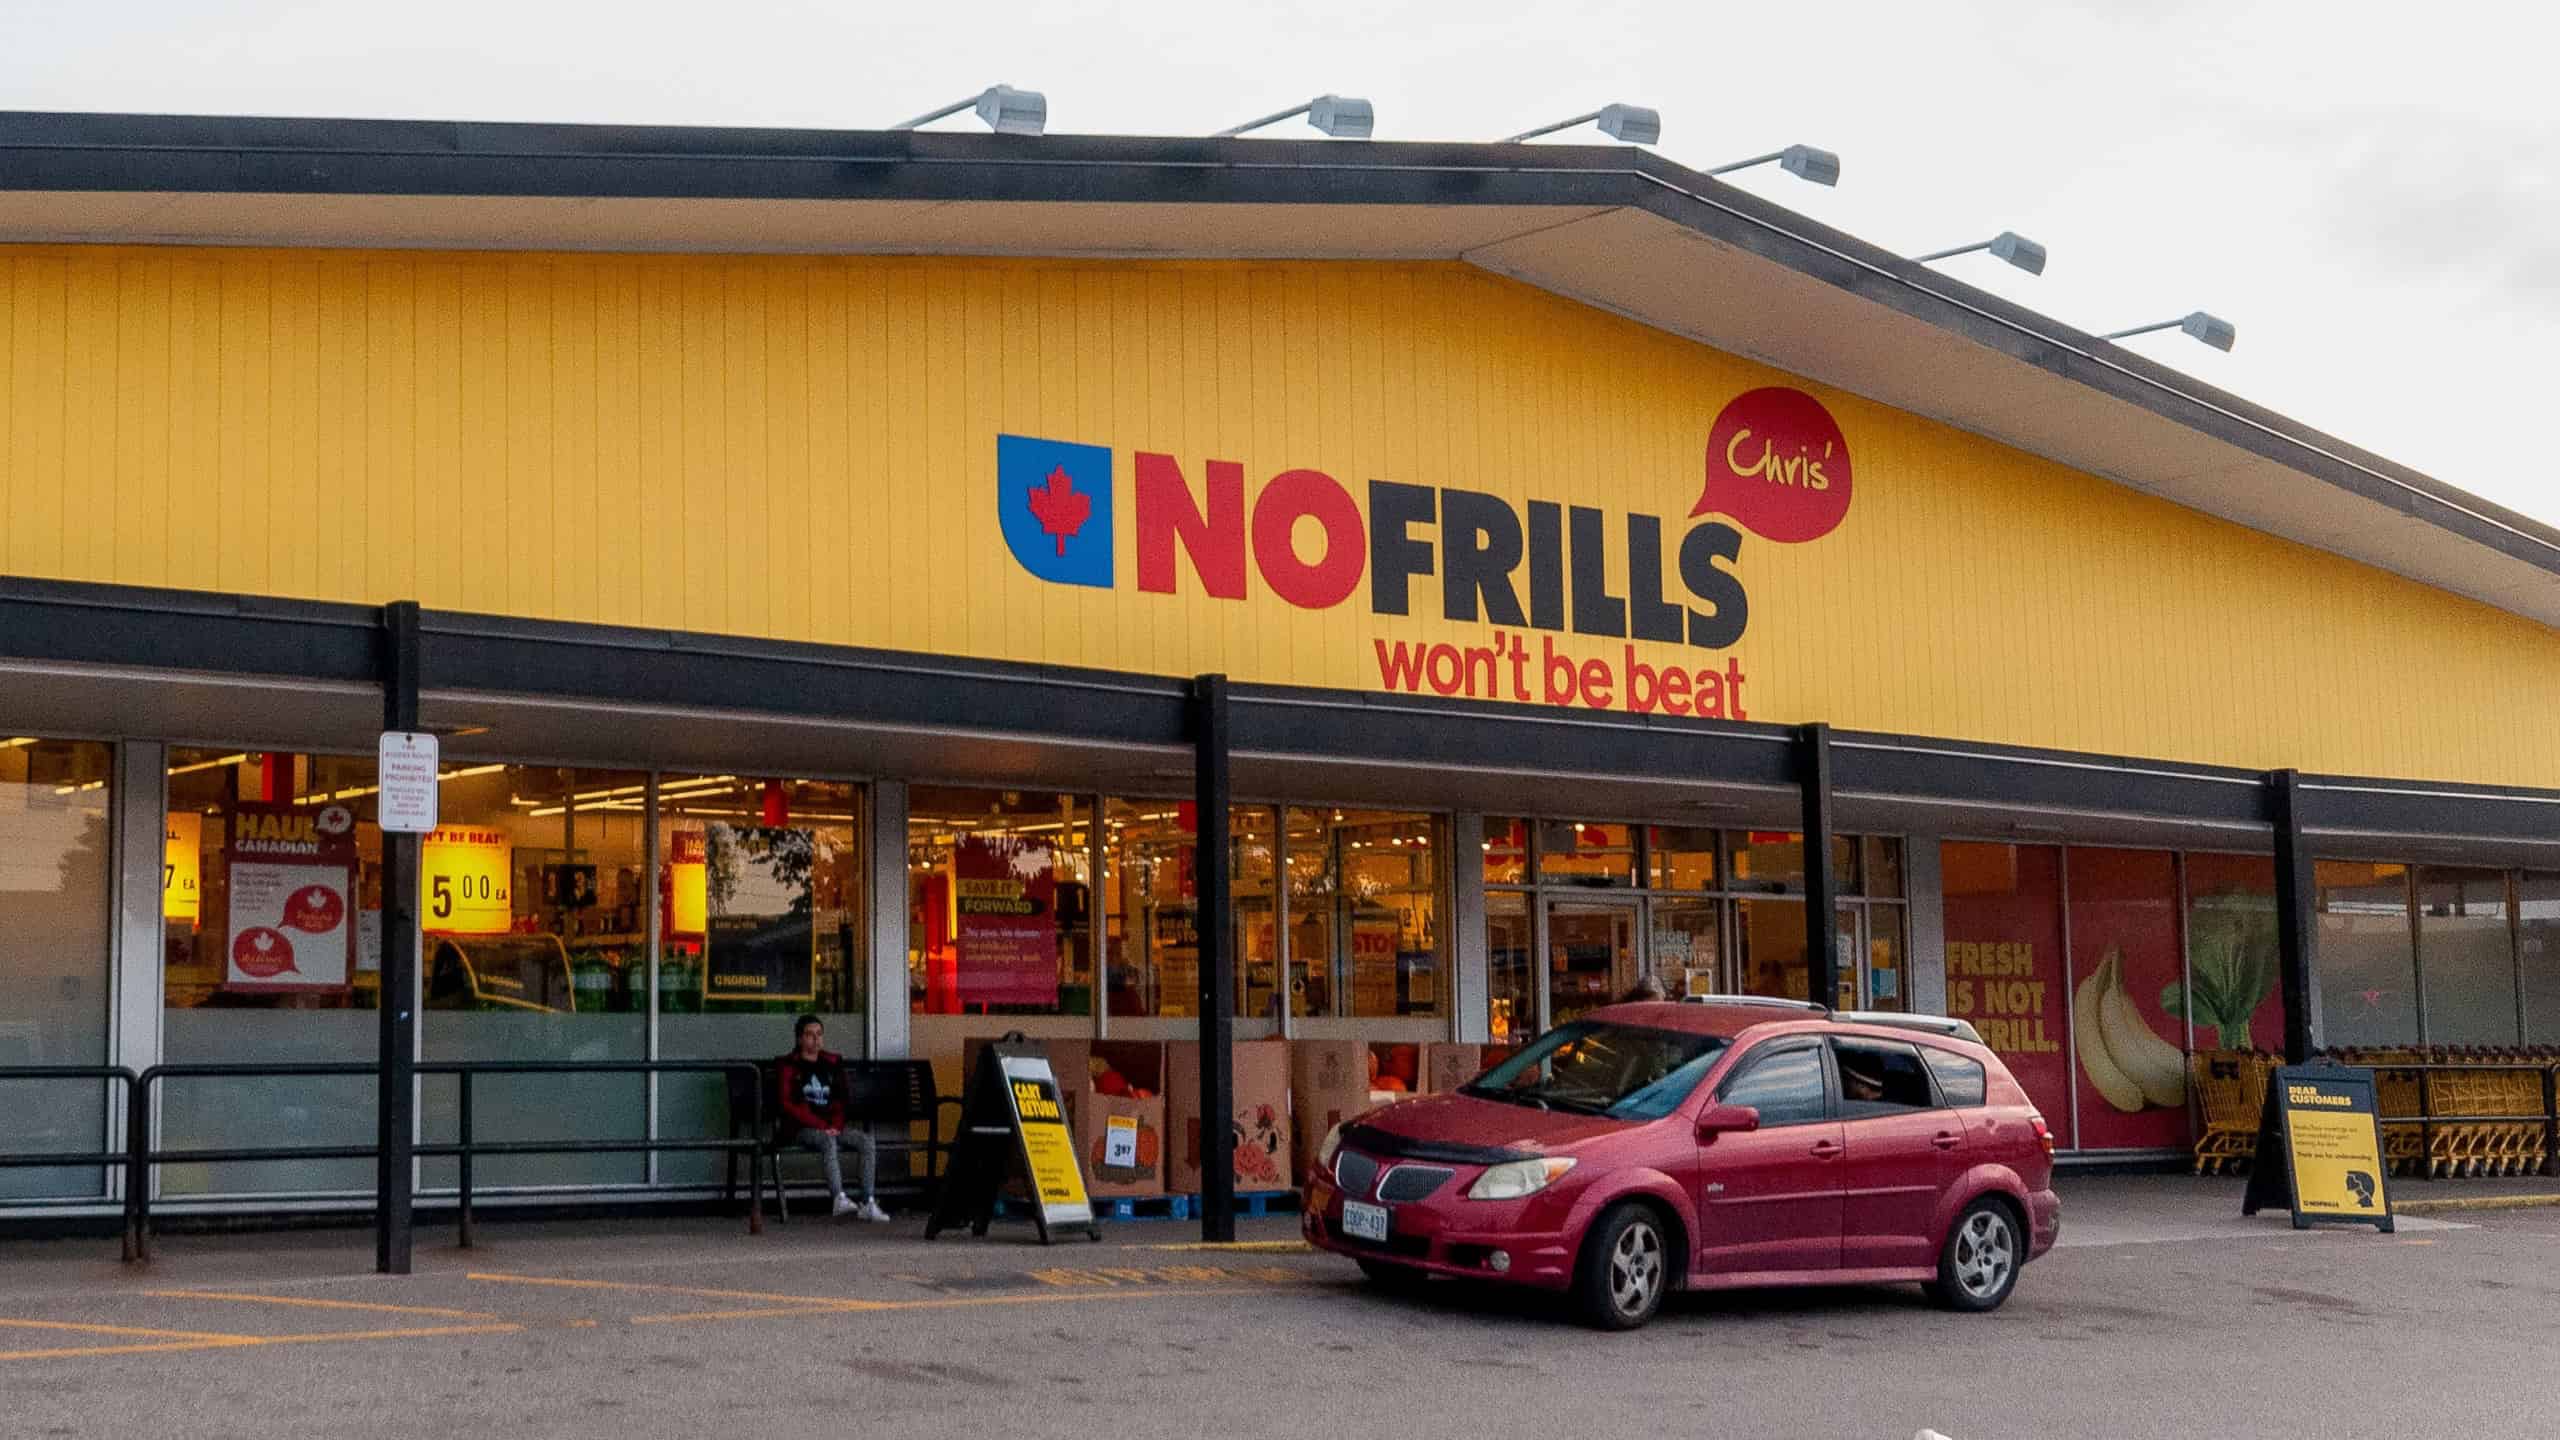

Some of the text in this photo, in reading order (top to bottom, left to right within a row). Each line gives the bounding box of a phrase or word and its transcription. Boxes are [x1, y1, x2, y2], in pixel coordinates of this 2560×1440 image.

[1727, 429, 1832, 490] Chris'
[1374, 630, 1747, 721] won't be beat
[392, 763, 425, 772] PARKING
[385, 773, 432, 783] PROHIBITED
[450, 832, 465, 842] BE
[469, 832, 499, 844] BEAT
[235, 840, 318, 854] CANADIAN
[433, 875, 452, 918] 5
[964, 899, 1032, 913] FORWARD
[1946, 942, 2032, 976] FRESH
[1948, 981, 2045, 1015] IS NOT
[1014, 1081, 1041, 1100] CART
[2288, 1086, 2318, 1095] DEAR
[1018, 1099, 1060, 1118] RETURN
[2289, 1095, 2352, 1106] CUSTOMERS
